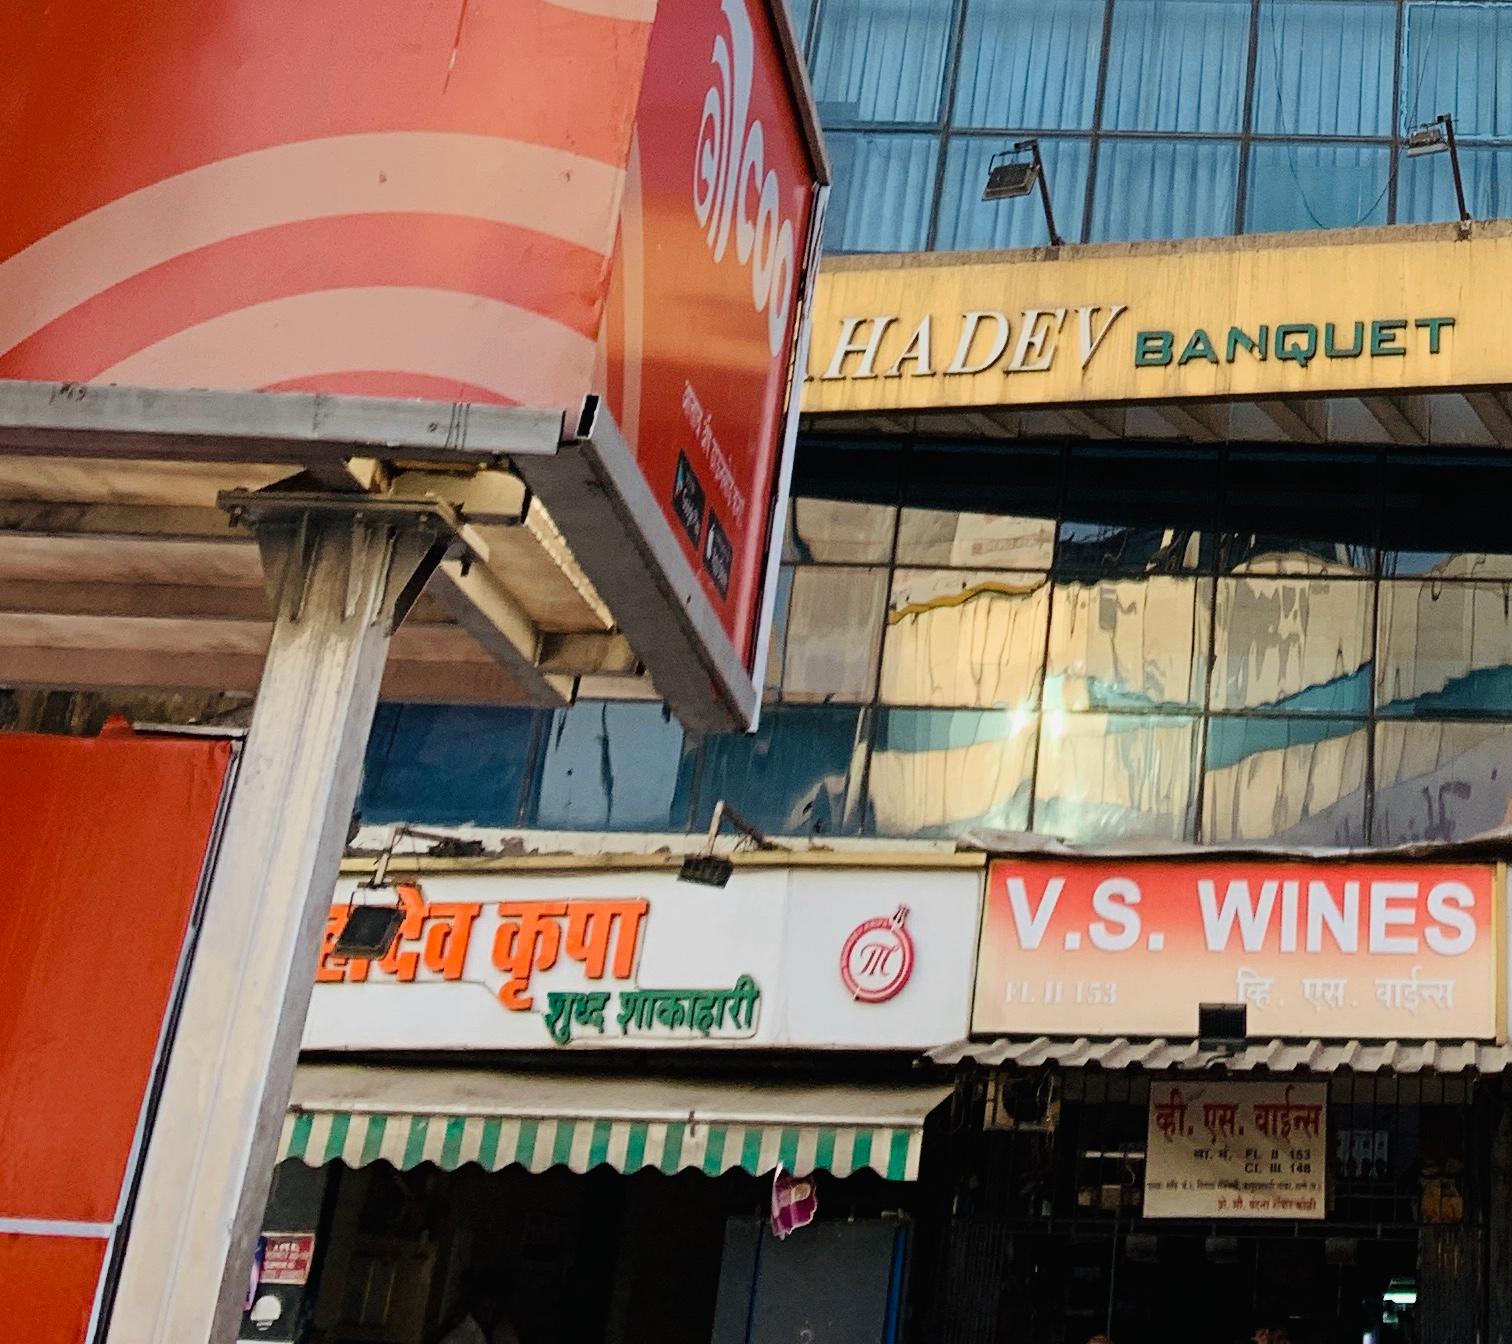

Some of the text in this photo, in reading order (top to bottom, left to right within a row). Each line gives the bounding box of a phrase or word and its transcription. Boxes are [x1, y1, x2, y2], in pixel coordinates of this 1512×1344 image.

[804, 304, 1456, 382] HADEV BANQUET
[492, 896, 651, 1011] कृपा
[1007, 877, 1478, 955] V.S. WINES
[618, 973, 760, 1038] शाकाहारी
[1073, 979, 1118, 1004] 153
